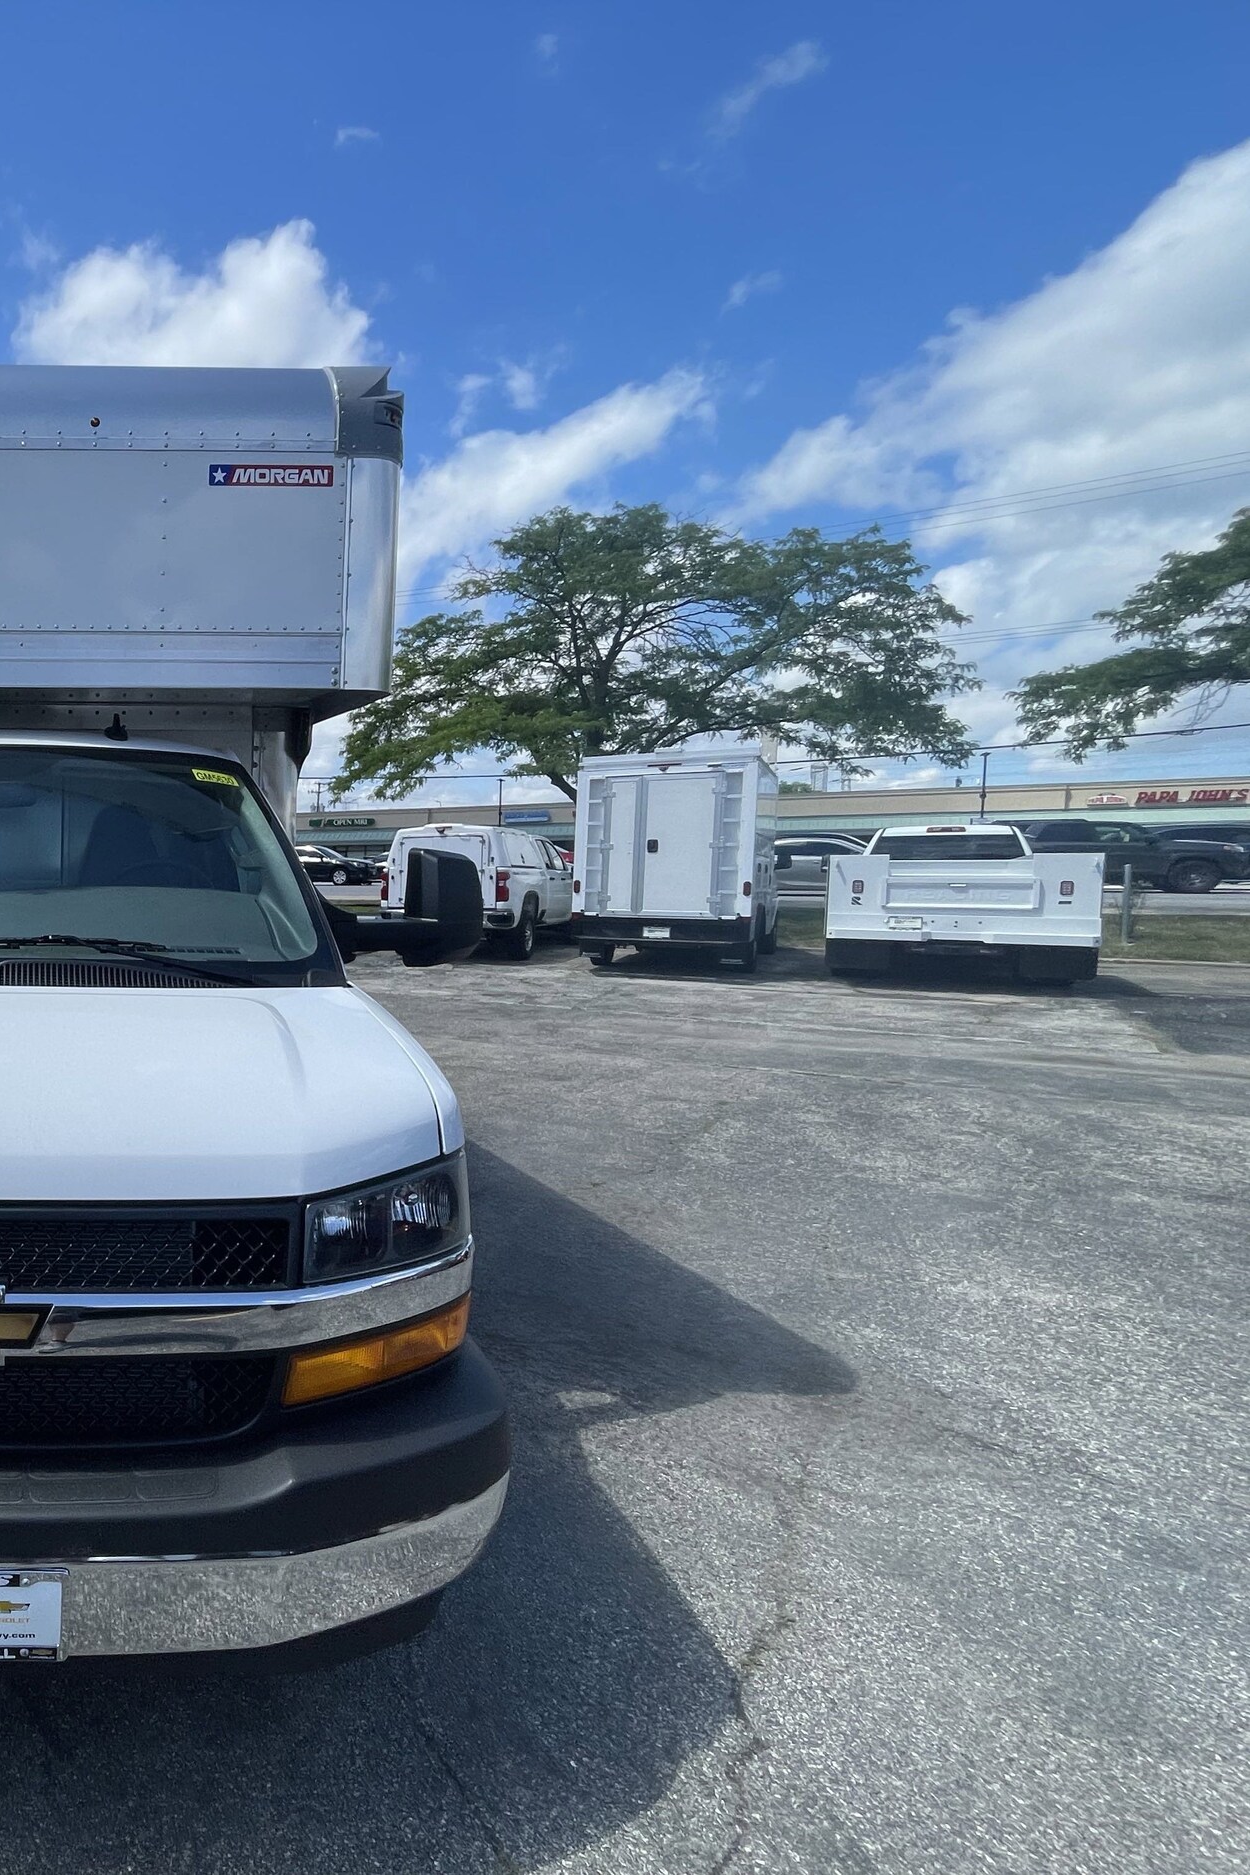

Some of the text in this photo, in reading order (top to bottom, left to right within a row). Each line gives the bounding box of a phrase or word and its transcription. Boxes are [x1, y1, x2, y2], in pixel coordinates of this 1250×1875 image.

[232, 468, 329, 484] MORGAN
[1135, 788, 1250, 804] PAPA JOHN'S
